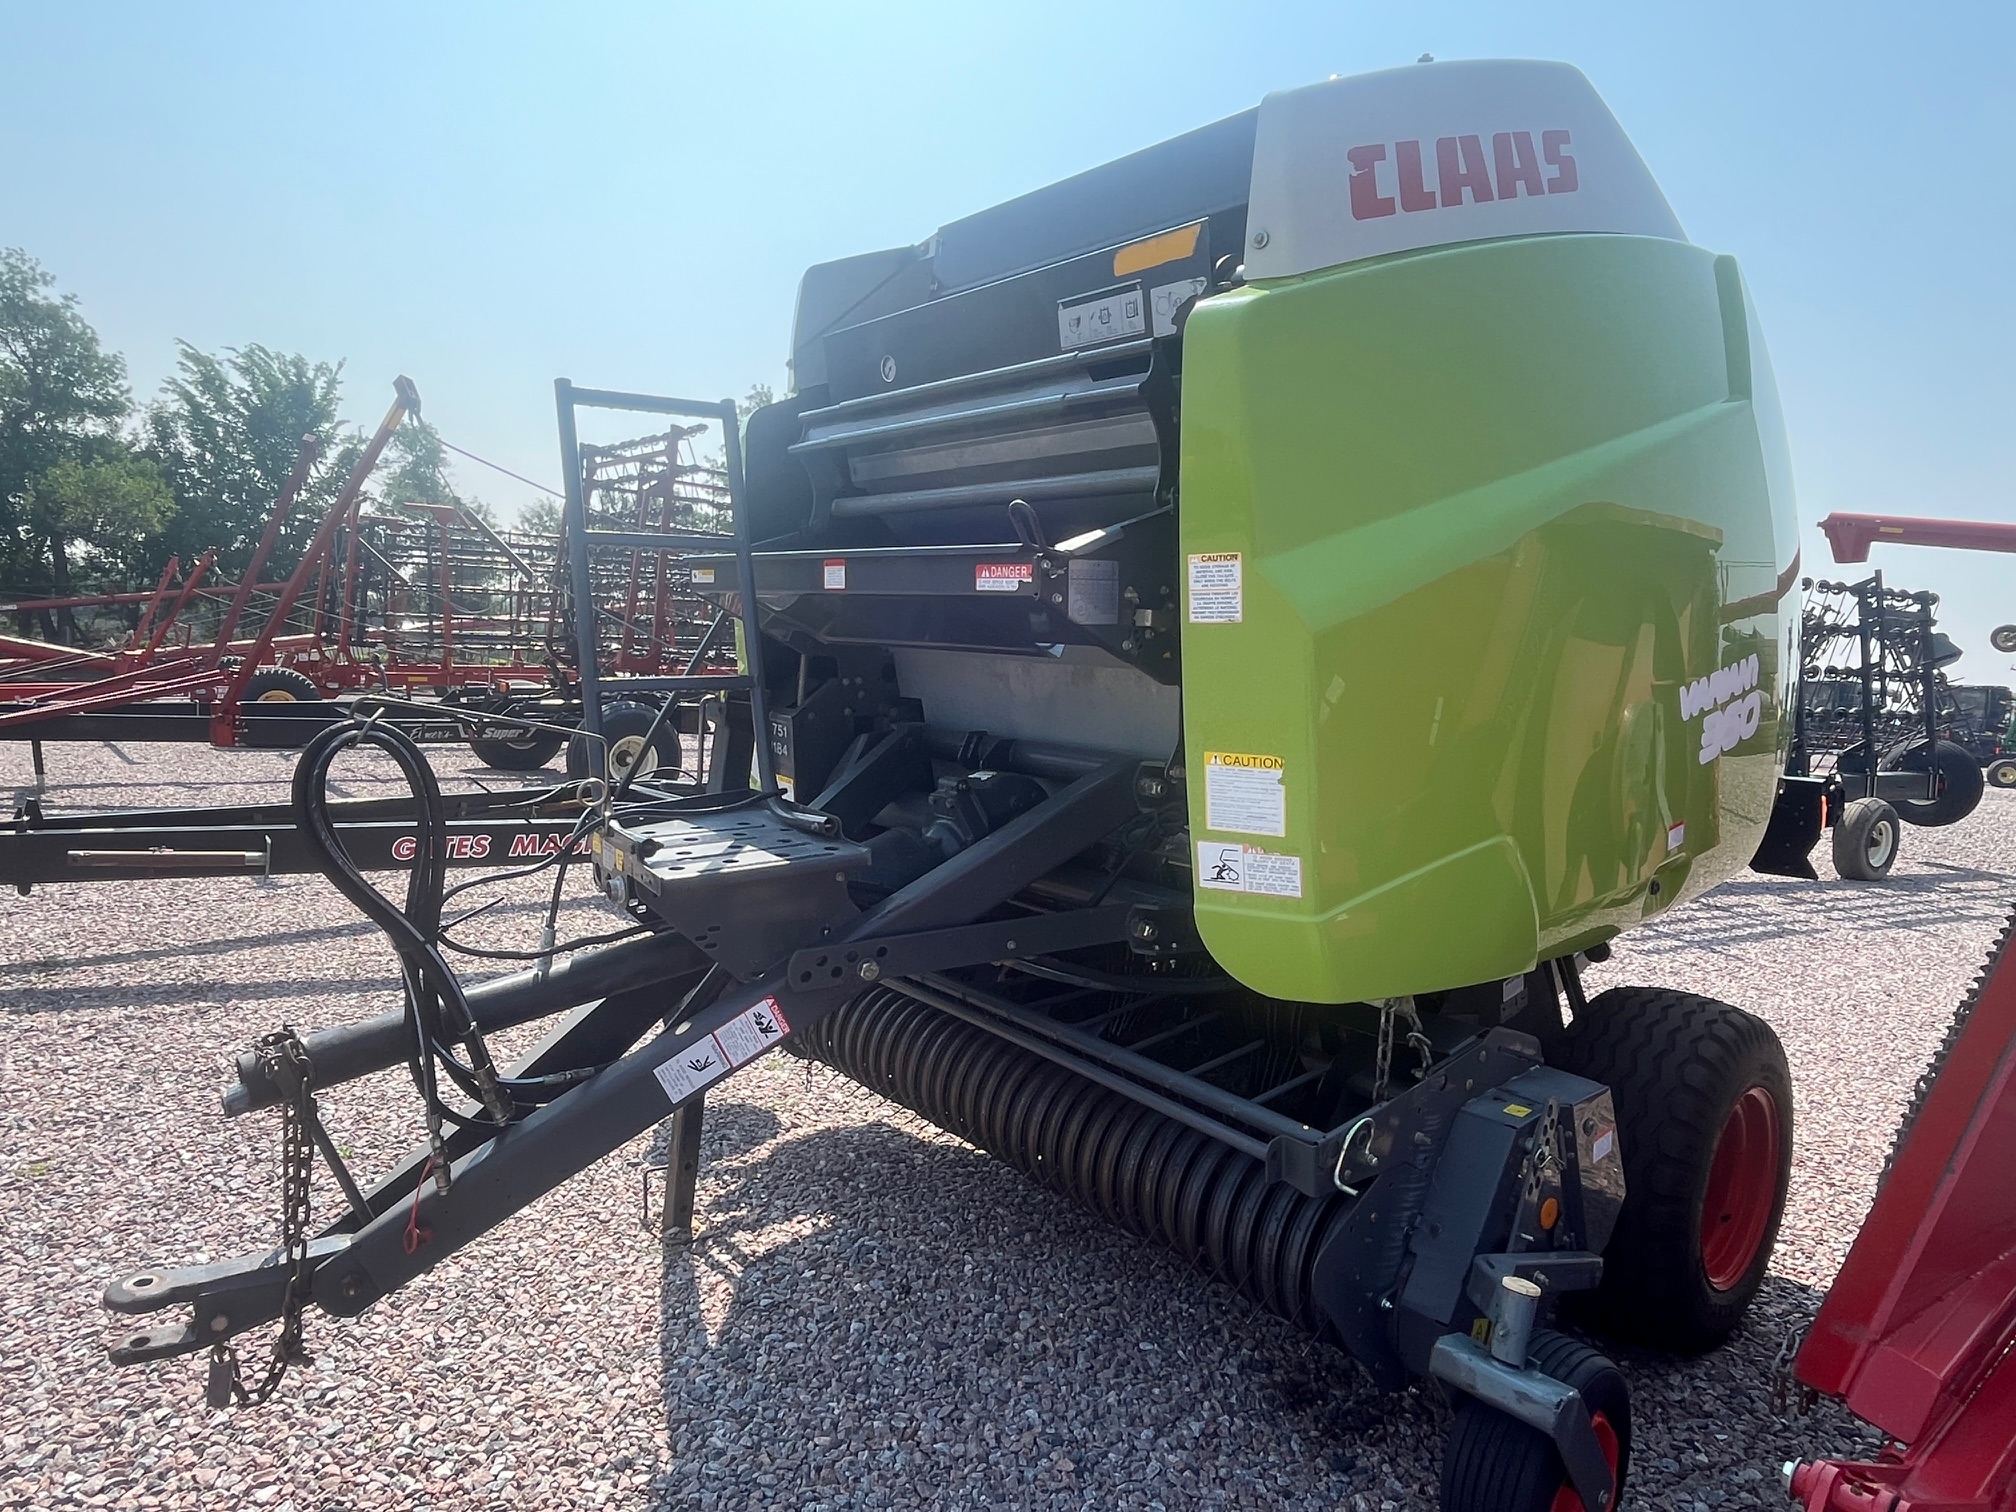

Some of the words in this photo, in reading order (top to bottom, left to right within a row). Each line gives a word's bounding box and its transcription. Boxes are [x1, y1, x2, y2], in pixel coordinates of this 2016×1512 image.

[1347, 130, 1579, 221] CLAAS
[1201, 554, 1239, 562] CAUTION
[991, 566, 1028, 578] DANGER
[482, 727, 524, 740] Super
[526, 727, 538, 738] 7
[772, 723, 787, 738] 751
[1223, 755, 1284, 769] CAUTION
[392, 835, 492, 861] GTES
[770, 1004, 790, 1035] DANGER
